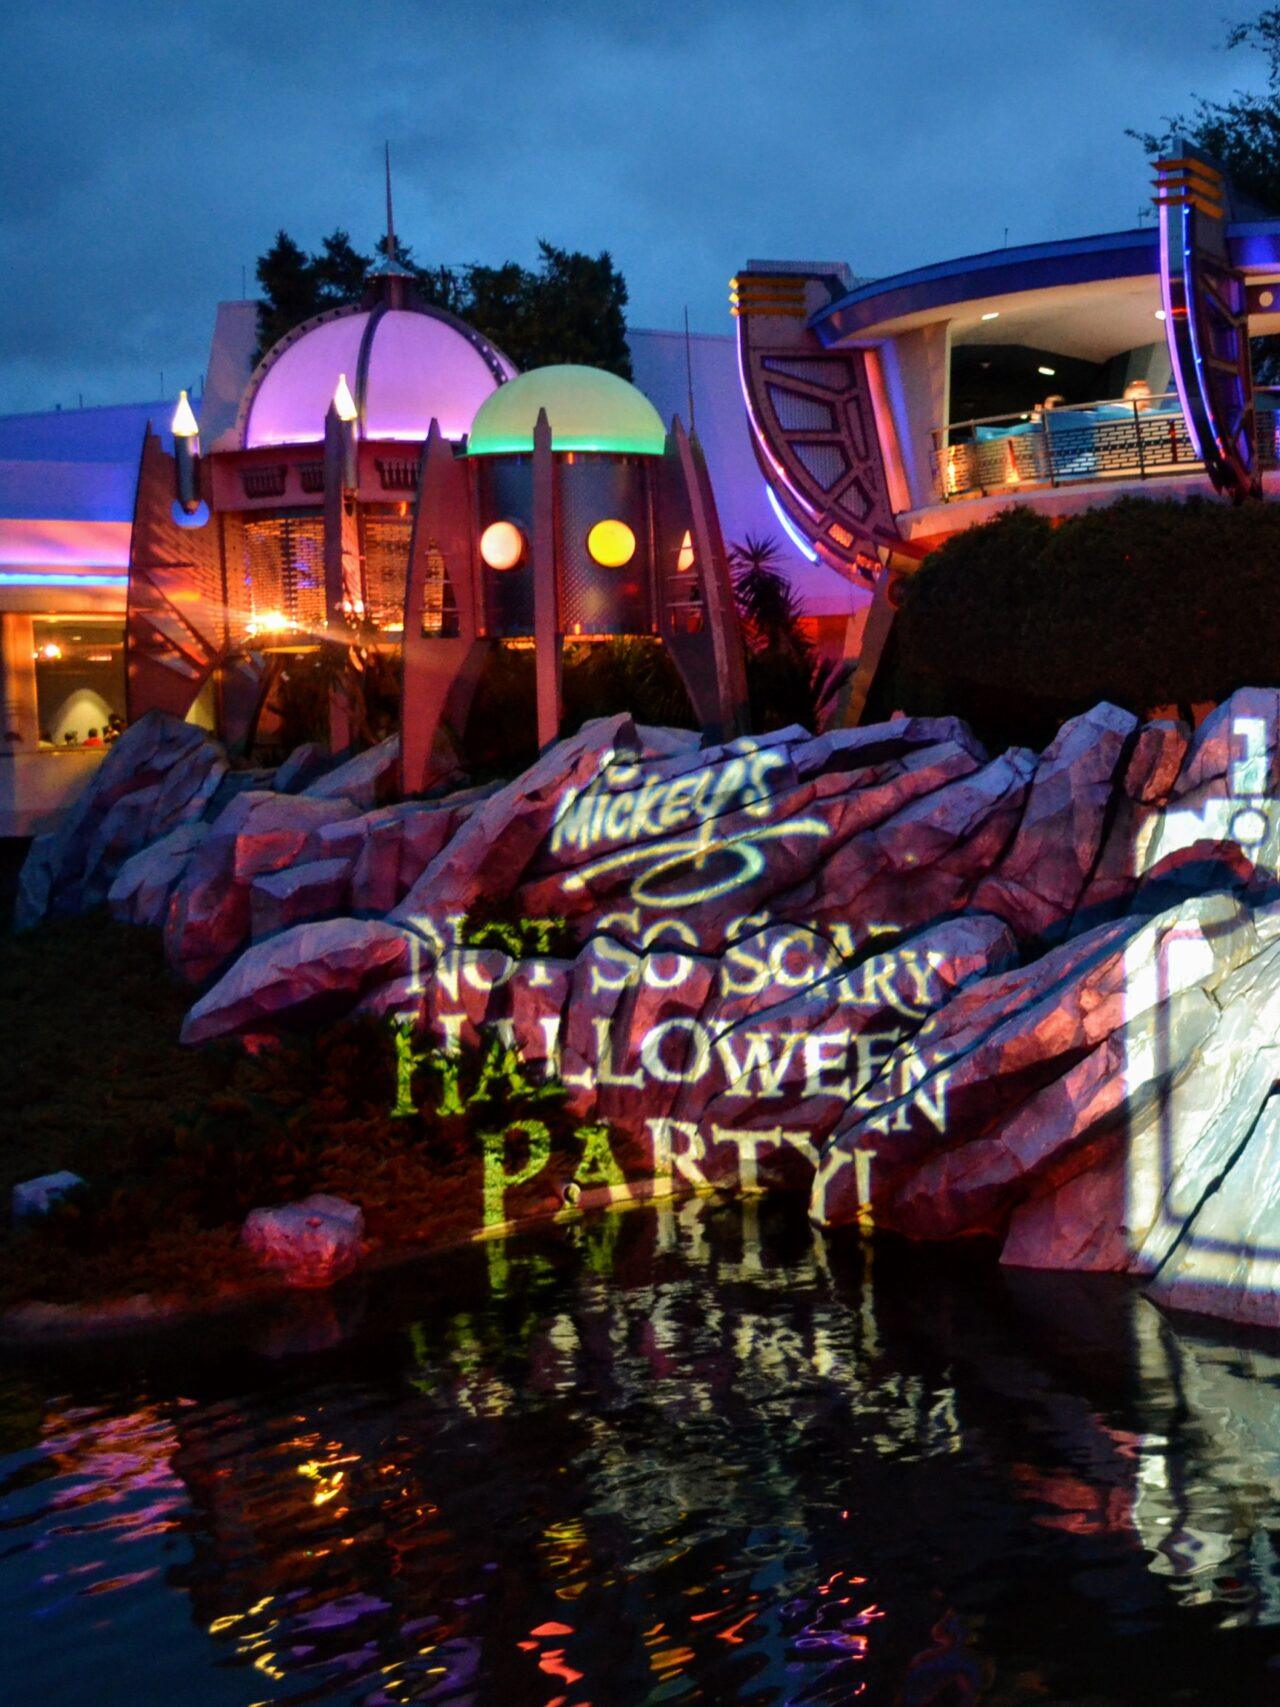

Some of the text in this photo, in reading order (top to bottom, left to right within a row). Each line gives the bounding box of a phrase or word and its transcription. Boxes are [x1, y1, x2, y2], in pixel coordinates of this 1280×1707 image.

[586, 909, 703, 996] SO
[388, 1011, 958, 1133] HALLOWEEN
[470, 1118, 878, 1242] PARTY!
